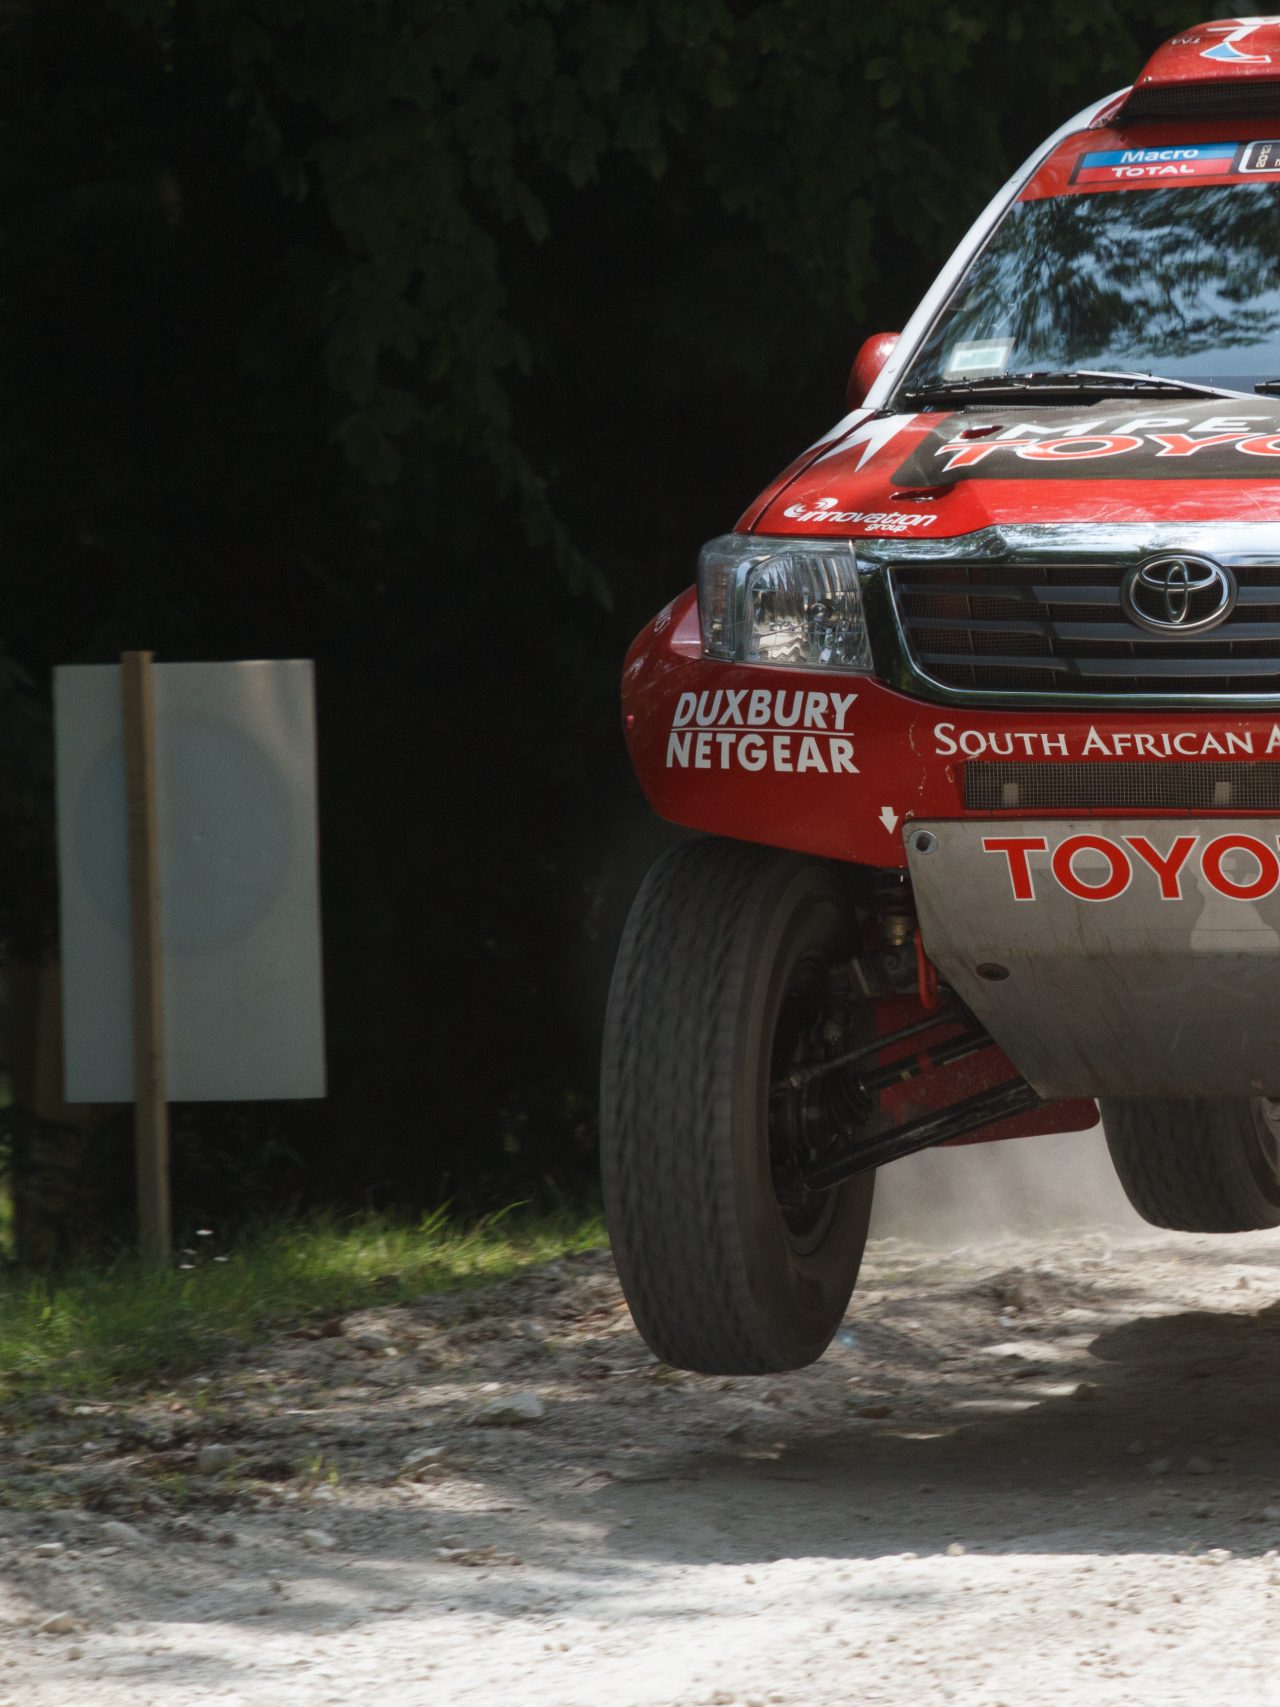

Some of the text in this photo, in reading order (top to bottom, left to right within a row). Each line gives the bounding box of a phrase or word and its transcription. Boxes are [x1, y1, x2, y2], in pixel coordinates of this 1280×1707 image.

[1120, 148, 1199, 164] Macro
[1111, 164, 1195, 178] TOTAL
[797, 510, 938, 527] innovation
[864, 523, 908, 533] group
[671, 689, 858, 731] DUXBURY
[933, 722, 1070, 756] SOUTH
[1081, 724, 1254, 758] AFRICAN
[665, 731, 860, 774] NETGEAR
